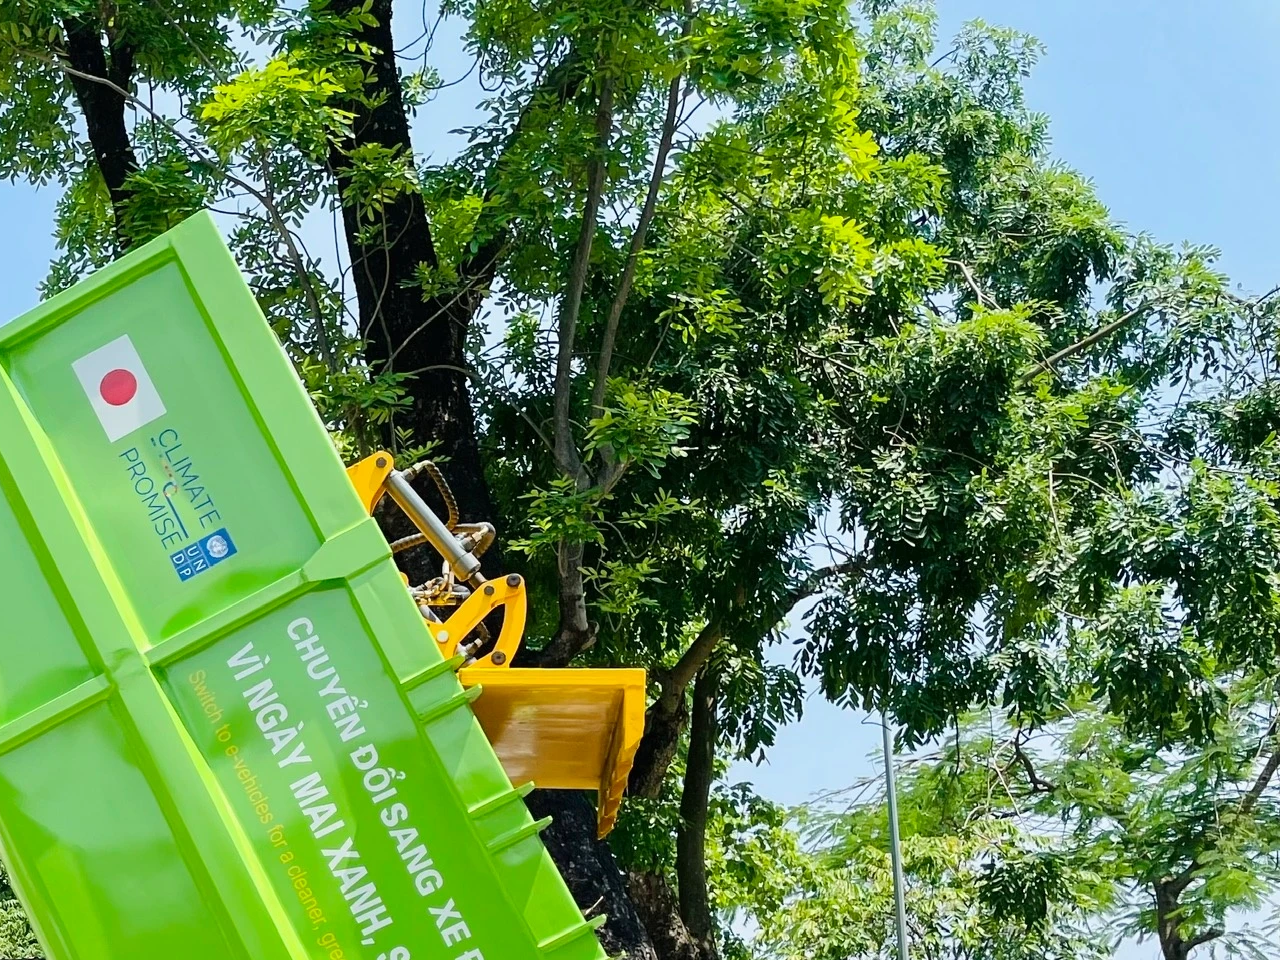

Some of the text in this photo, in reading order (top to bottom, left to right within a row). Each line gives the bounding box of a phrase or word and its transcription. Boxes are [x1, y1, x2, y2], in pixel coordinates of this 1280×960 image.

[118, 447, 183, 550] PROMISE
[158, 428, 222, 529] CLIMATE
[172, 554, 192, 580] DP
[186, 545, 207, 571] UN
[226, 641, 271, 681] VÌ
[242, 678, 313, 769] NGÀY
[188, 669, 225, 724] Switch
[215, 722, 232, 743] to
[224, 745, 273, 825] e-vehicles
[266, 823, 288, 848] for
[279, 851, 295, 865] a
[287, 865, 327, 931] cleaner,
[287, 617, 369, 742] CHUYỂN
[349, 743, 408, 804] ĐỔI
[380, 802, 443, 896] SANG
[428, 898, 471, 947] XE
[289, 771, 345, 839] MAI
[321, 836, 393, 946] XANH,
